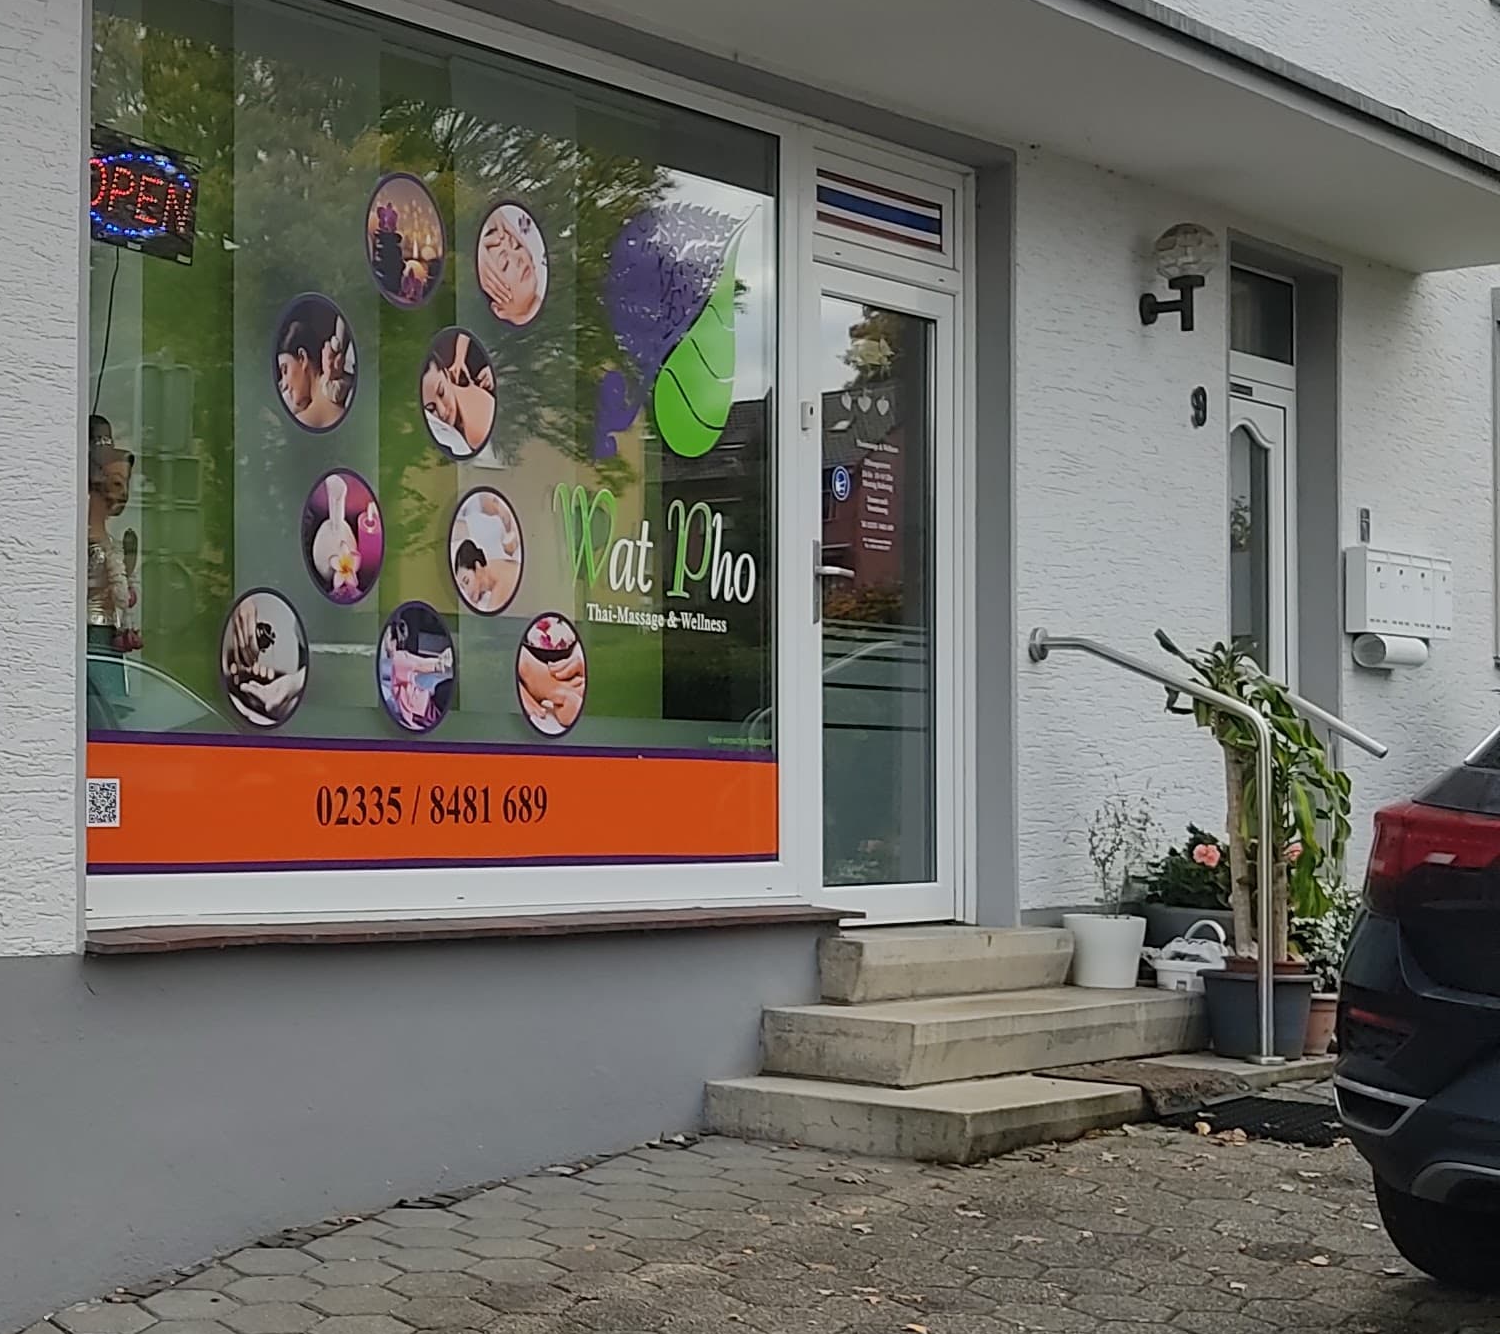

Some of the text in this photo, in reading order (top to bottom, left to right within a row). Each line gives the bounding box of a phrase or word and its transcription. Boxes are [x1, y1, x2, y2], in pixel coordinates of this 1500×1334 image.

[1190, 385, 1207, 429] 9
[552, 482, 757, 604] Wat Pho
[586, 603, 728, 633] Thai-Massage & Wellness
[316, 784, 548, 826] 02335 / 8481 689
